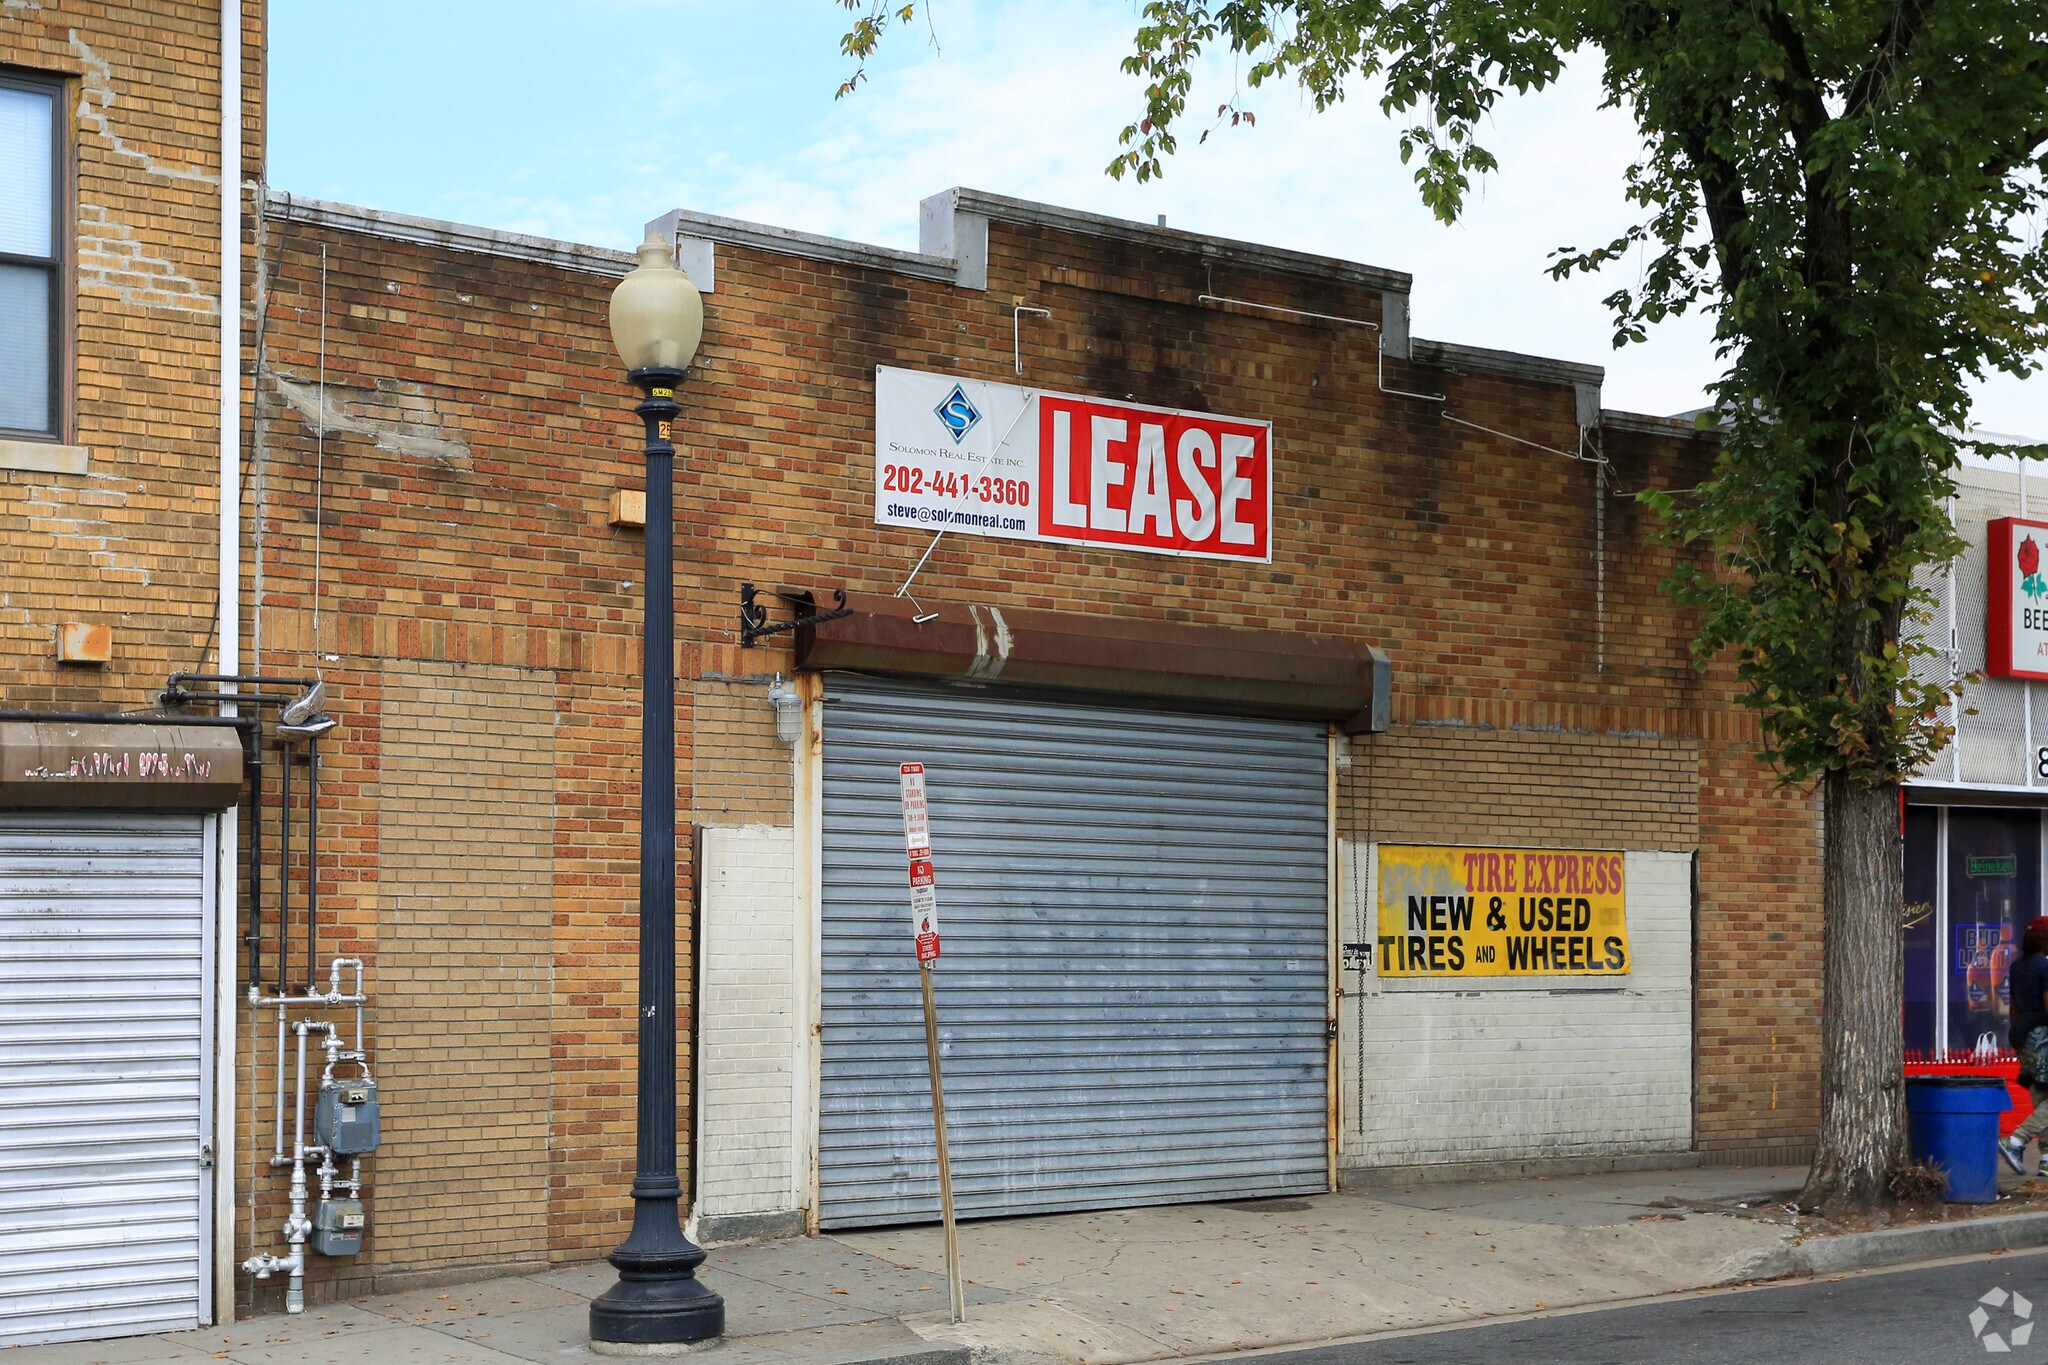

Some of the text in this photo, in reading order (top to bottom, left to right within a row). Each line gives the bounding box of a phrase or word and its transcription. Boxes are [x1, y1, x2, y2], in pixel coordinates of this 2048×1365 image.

[939, 448, 966, 461] REAL
[1006, 459, 1026, 468] INC.
[883, 464, 1030, 507] 202-441-3360
[1052, 409, 1255, 546] LEASE
[910, 799, 925, 809] PARKING
[912, 875, 931, 886] PARKING
[917, 865, 924, 875] NO
[1463, 852, 1622, 895] TIRE EXPRESS
[1408, 895, 1591, 932] NEW & USED
[1966, 928, 2001, 949] BUD
[1378, 935, 1626, 971] TIRES AND WHEELS
